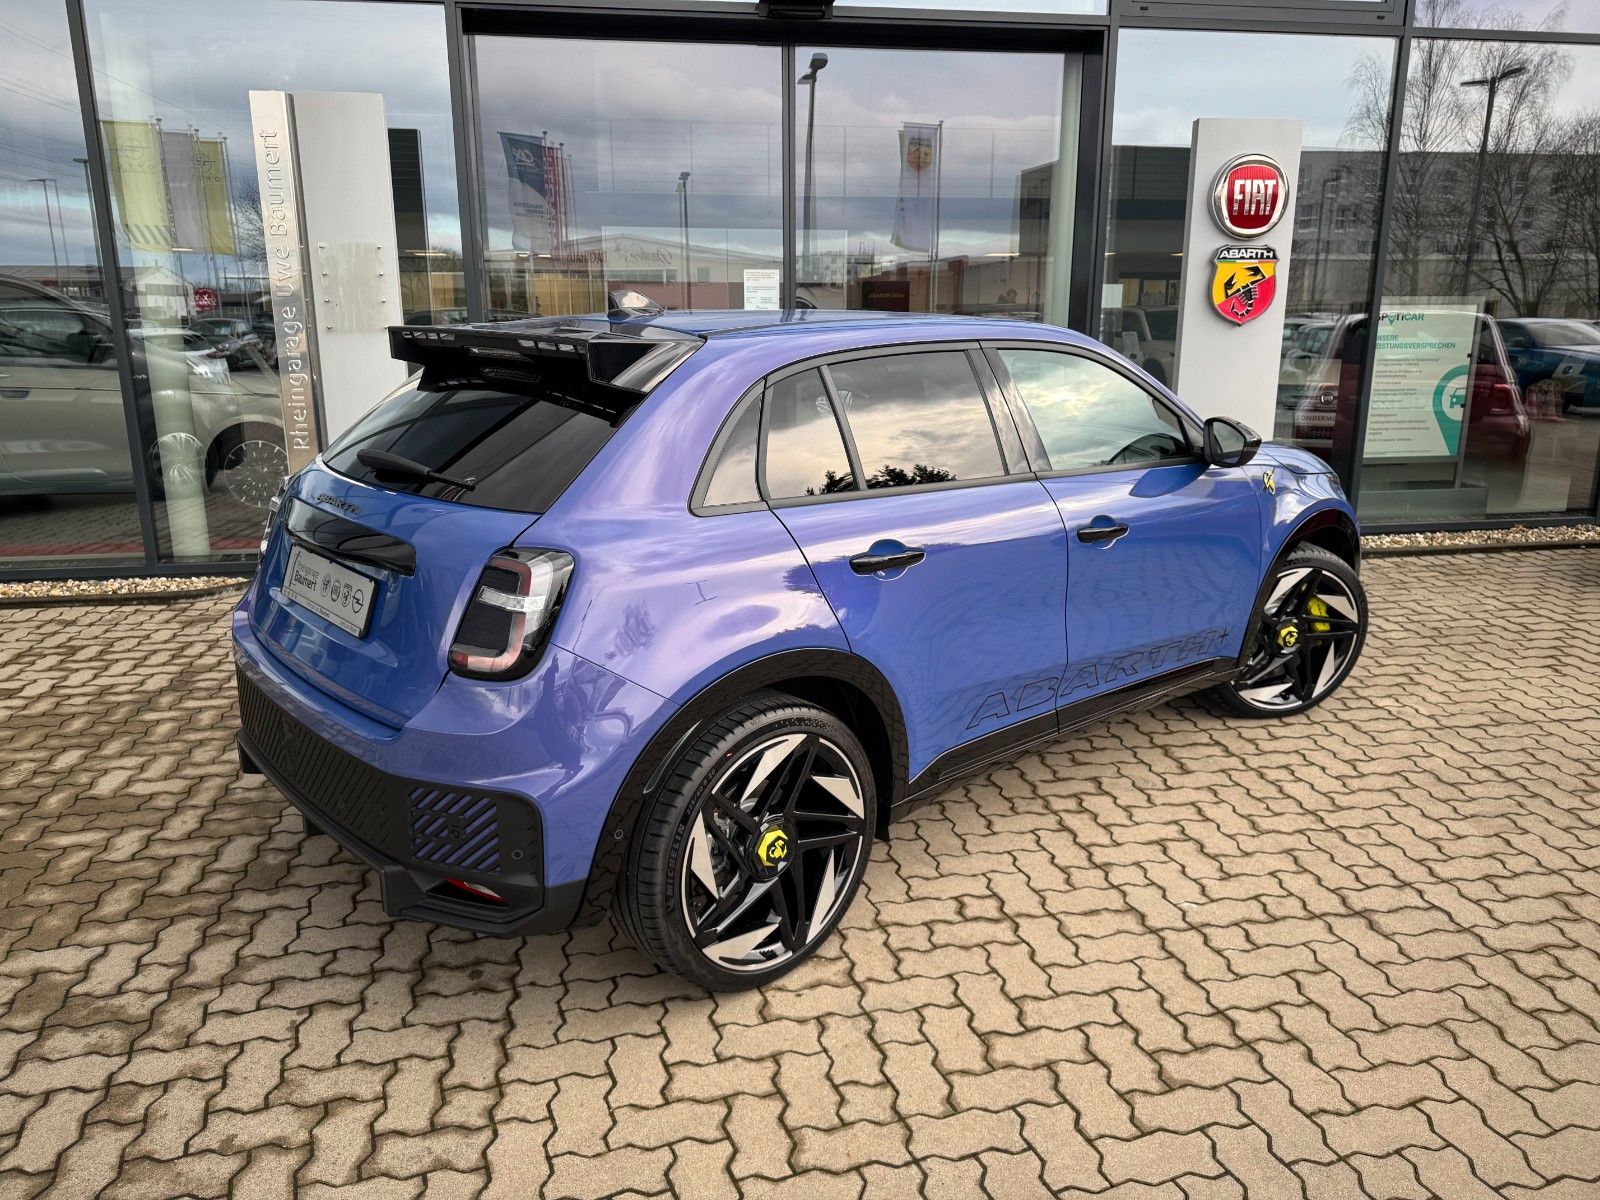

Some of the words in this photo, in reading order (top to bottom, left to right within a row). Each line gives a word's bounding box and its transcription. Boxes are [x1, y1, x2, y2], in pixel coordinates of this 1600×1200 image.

[259, 130, 288, 236] Baumert
[1233, 179, 1277, 216] FIAT
[276, 247, 294, 297] Uwe
[1219, 248, 1274, 259] ABARTH
[1375, 342, 1456, 350] EISTUNGSVERSPRECHEN
[281, 306, 309, 449] Rheingarage
